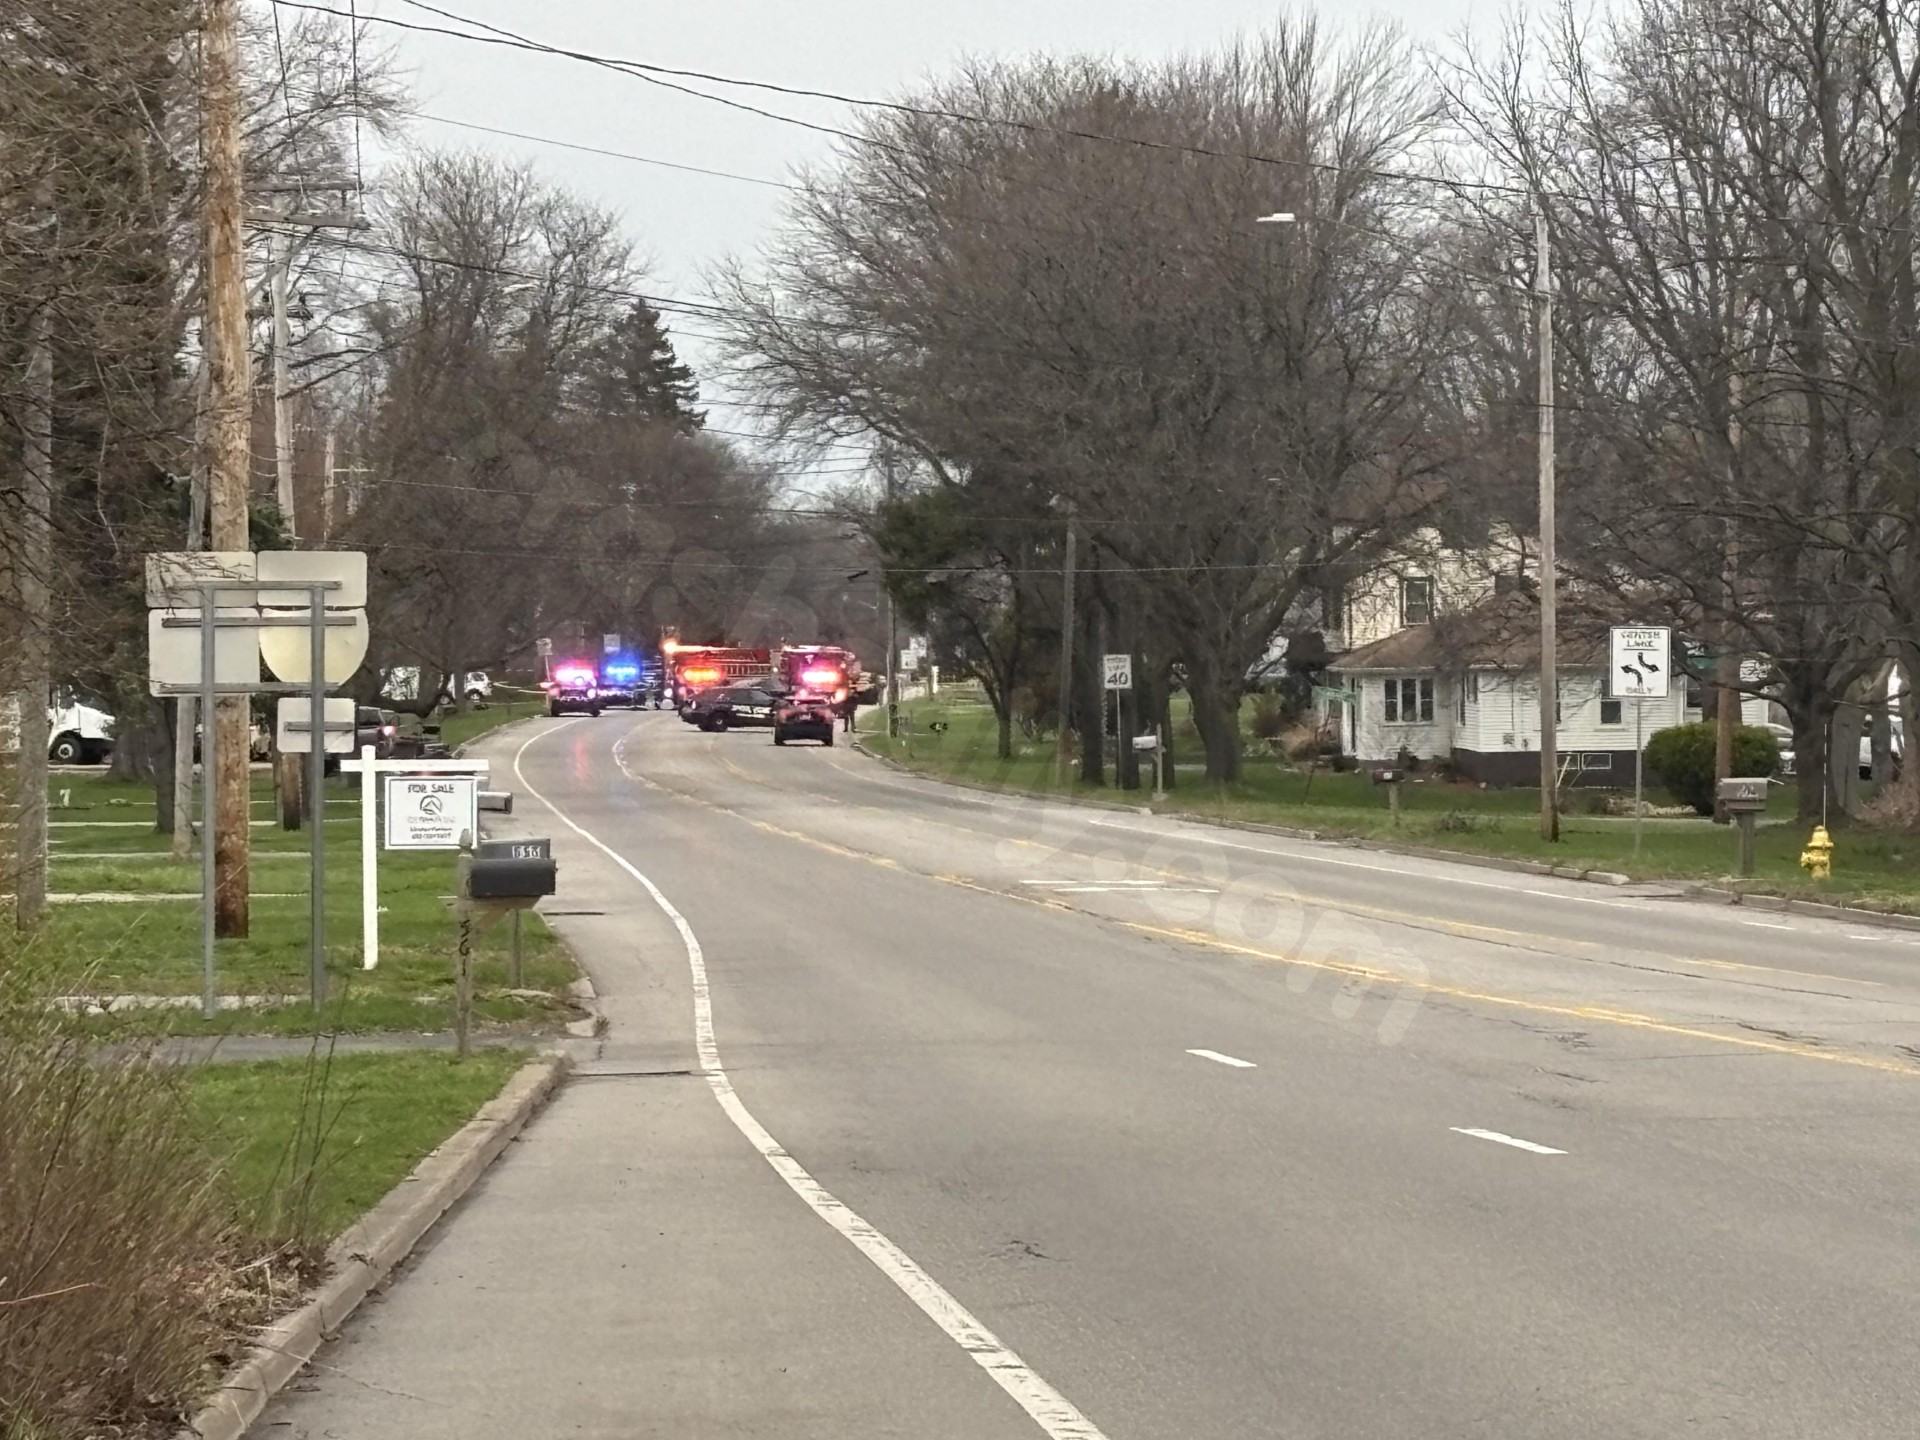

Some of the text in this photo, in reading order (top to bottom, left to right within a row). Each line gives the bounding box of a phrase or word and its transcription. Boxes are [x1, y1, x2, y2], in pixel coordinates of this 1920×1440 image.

[1106, 671, 1128, 686] 40
[408, 783, 455, 793] FOR SALE
